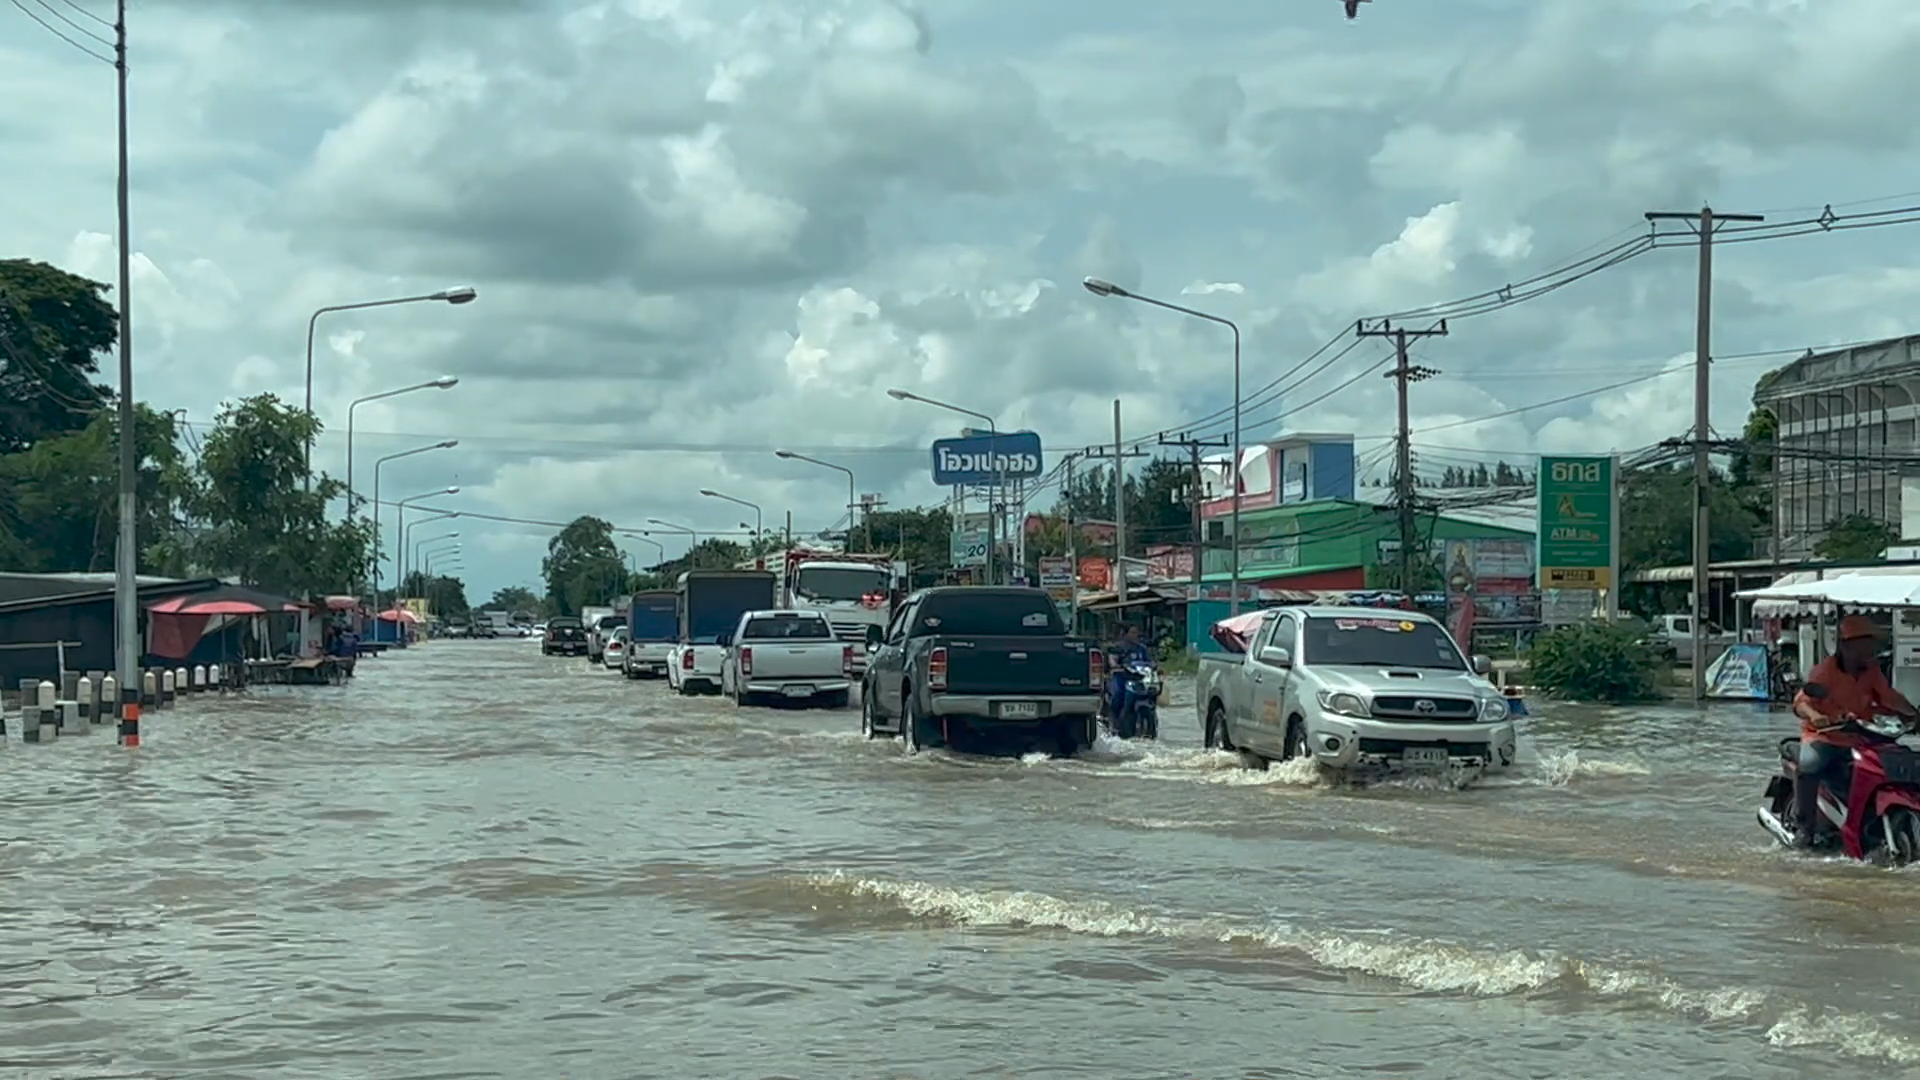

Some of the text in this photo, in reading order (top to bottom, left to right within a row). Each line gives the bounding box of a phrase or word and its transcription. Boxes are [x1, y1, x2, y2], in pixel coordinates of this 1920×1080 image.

[1551, 462, 1601, 481] ธกส
[1550, 527, 1577, 539] ATM
[968, 544, 986, 557] 20
